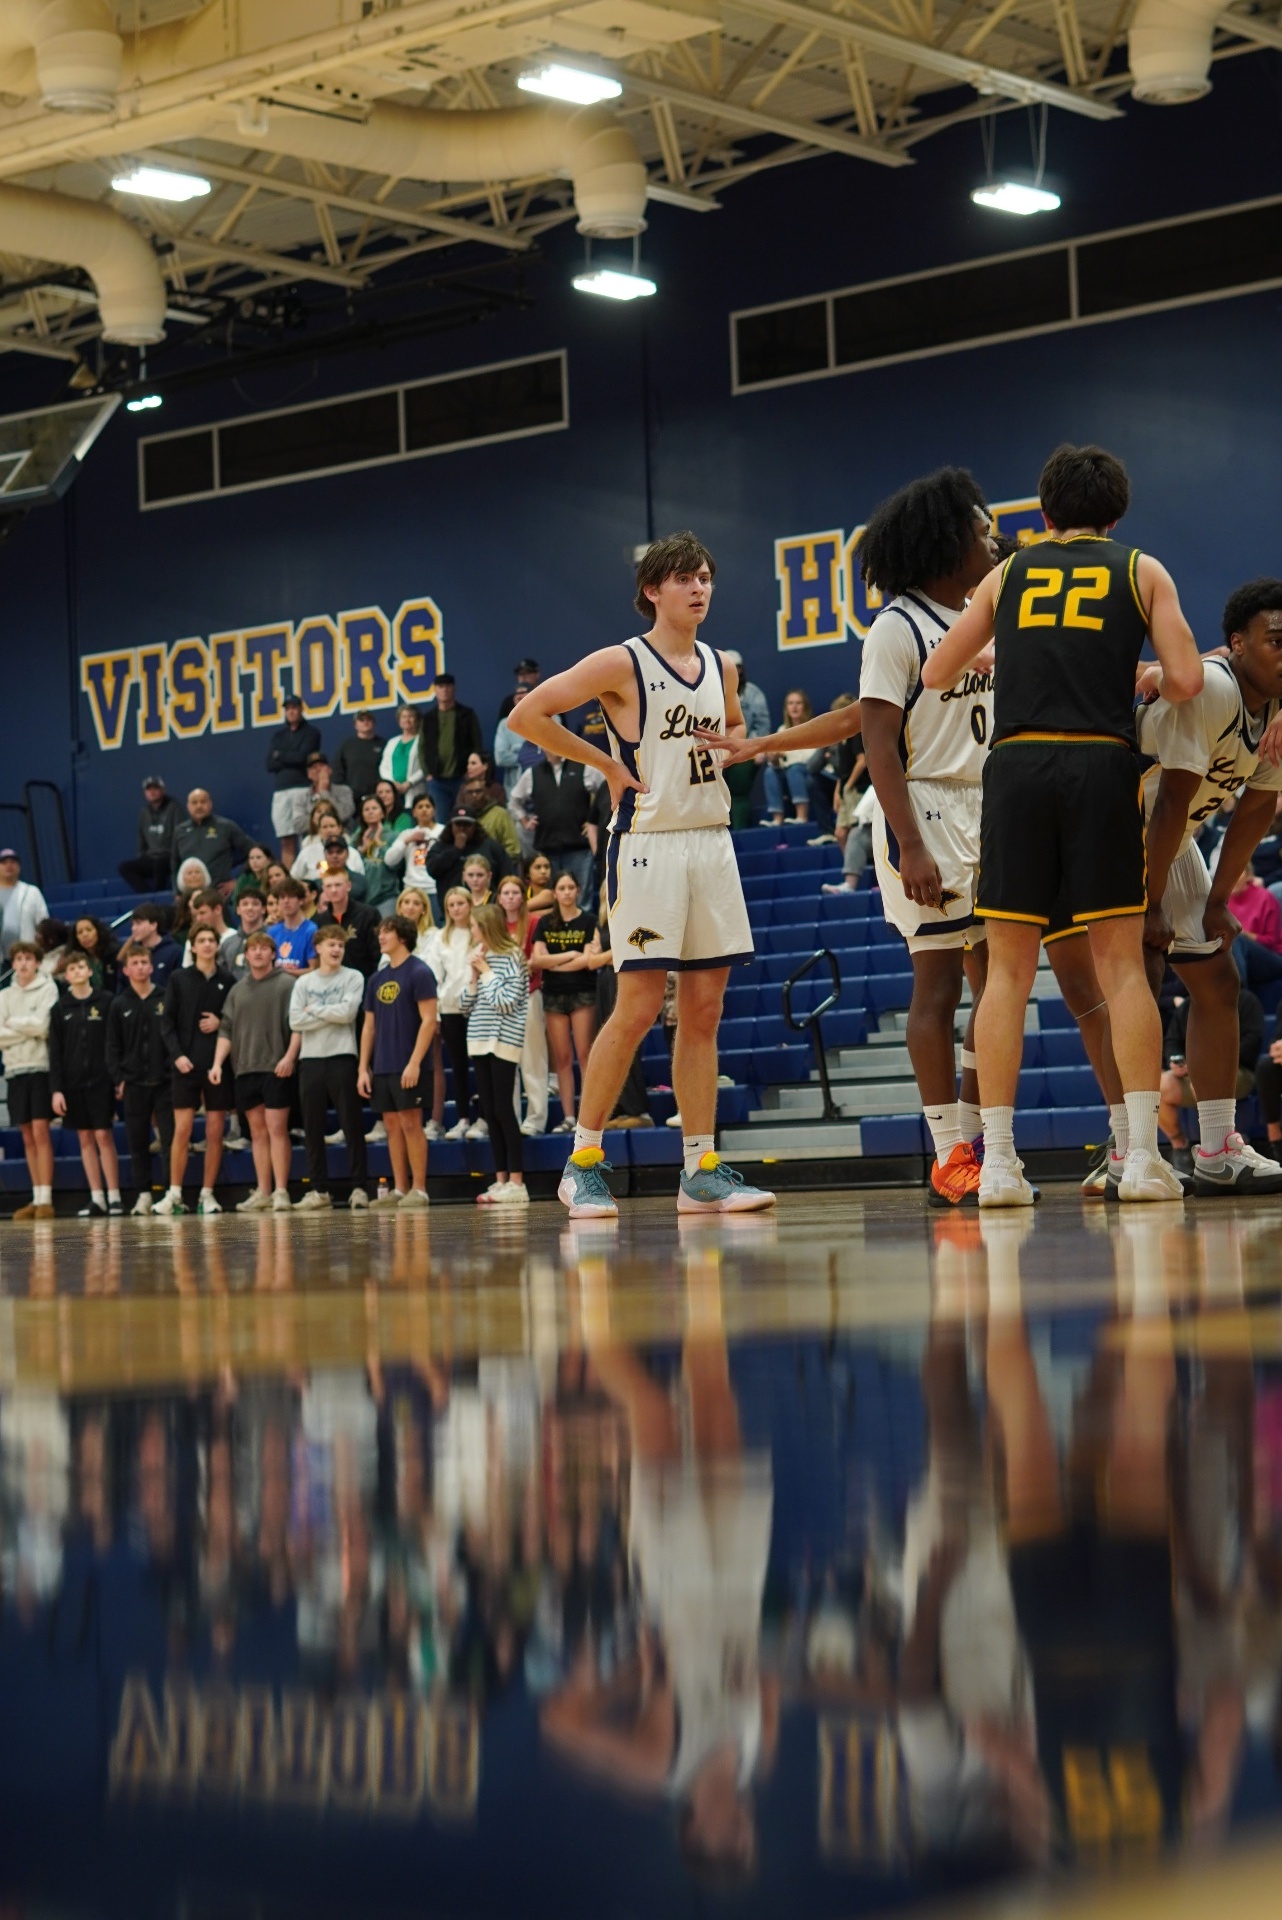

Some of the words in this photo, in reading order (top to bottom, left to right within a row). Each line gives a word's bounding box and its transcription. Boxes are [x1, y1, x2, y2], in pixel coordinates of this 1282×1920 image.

[1018, 566, 1112, 631] 22
[79, 596, 445, 752] VISITORS
[970, 704, 987, 744] 0
[687, 745, 717, 786] 12
[1189, 797, 1225, 822] 2
